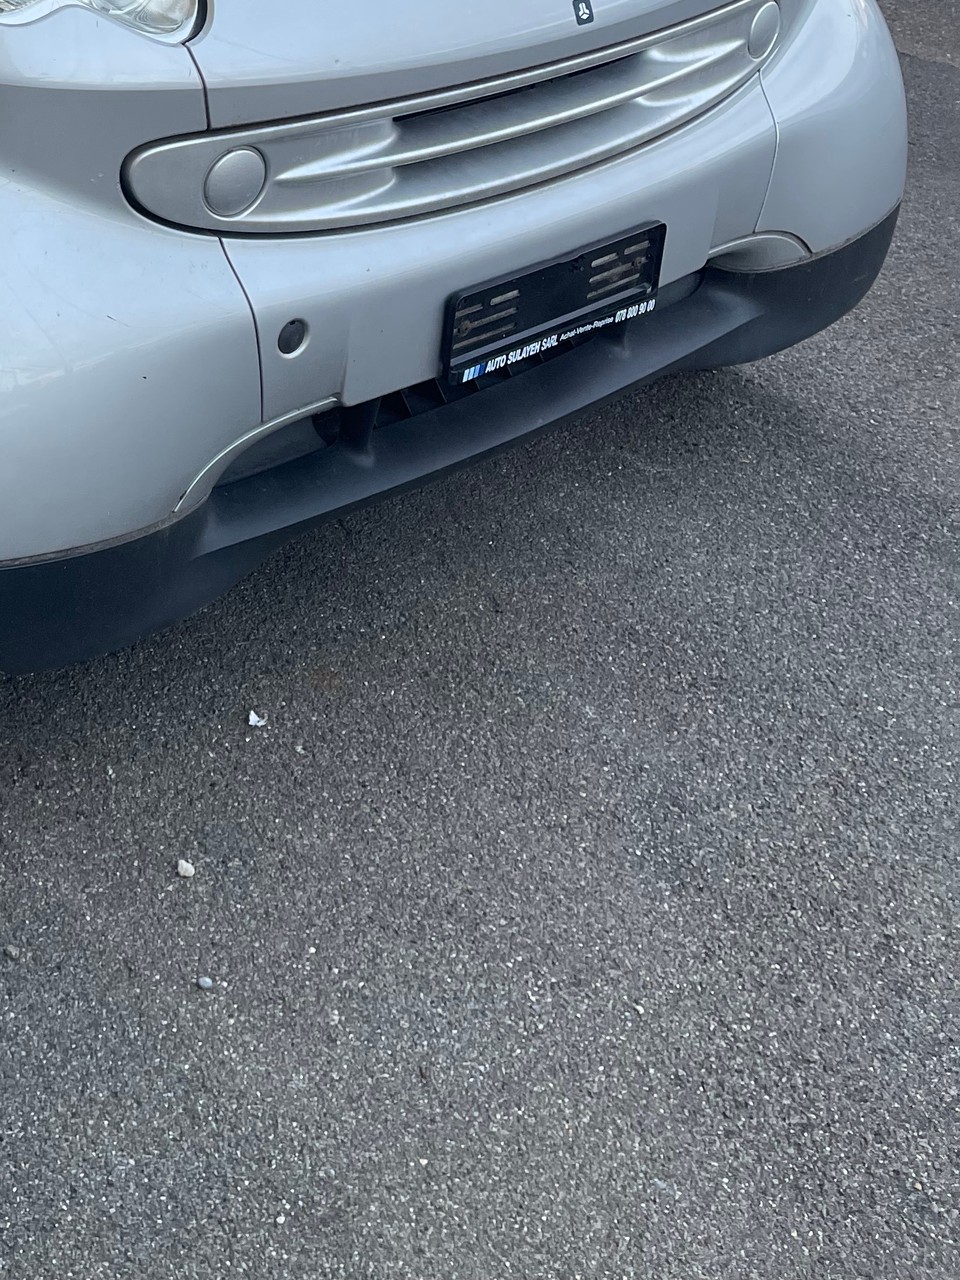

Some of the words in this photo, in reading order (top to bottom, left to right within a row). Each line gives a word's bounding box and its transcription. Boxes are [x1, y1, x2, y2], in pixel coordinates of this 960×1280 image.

[485, 354, 507, 373] AUTO
[507, 341, 541, 365] SULAYEH
[541, 334, 558, 351] SARL
